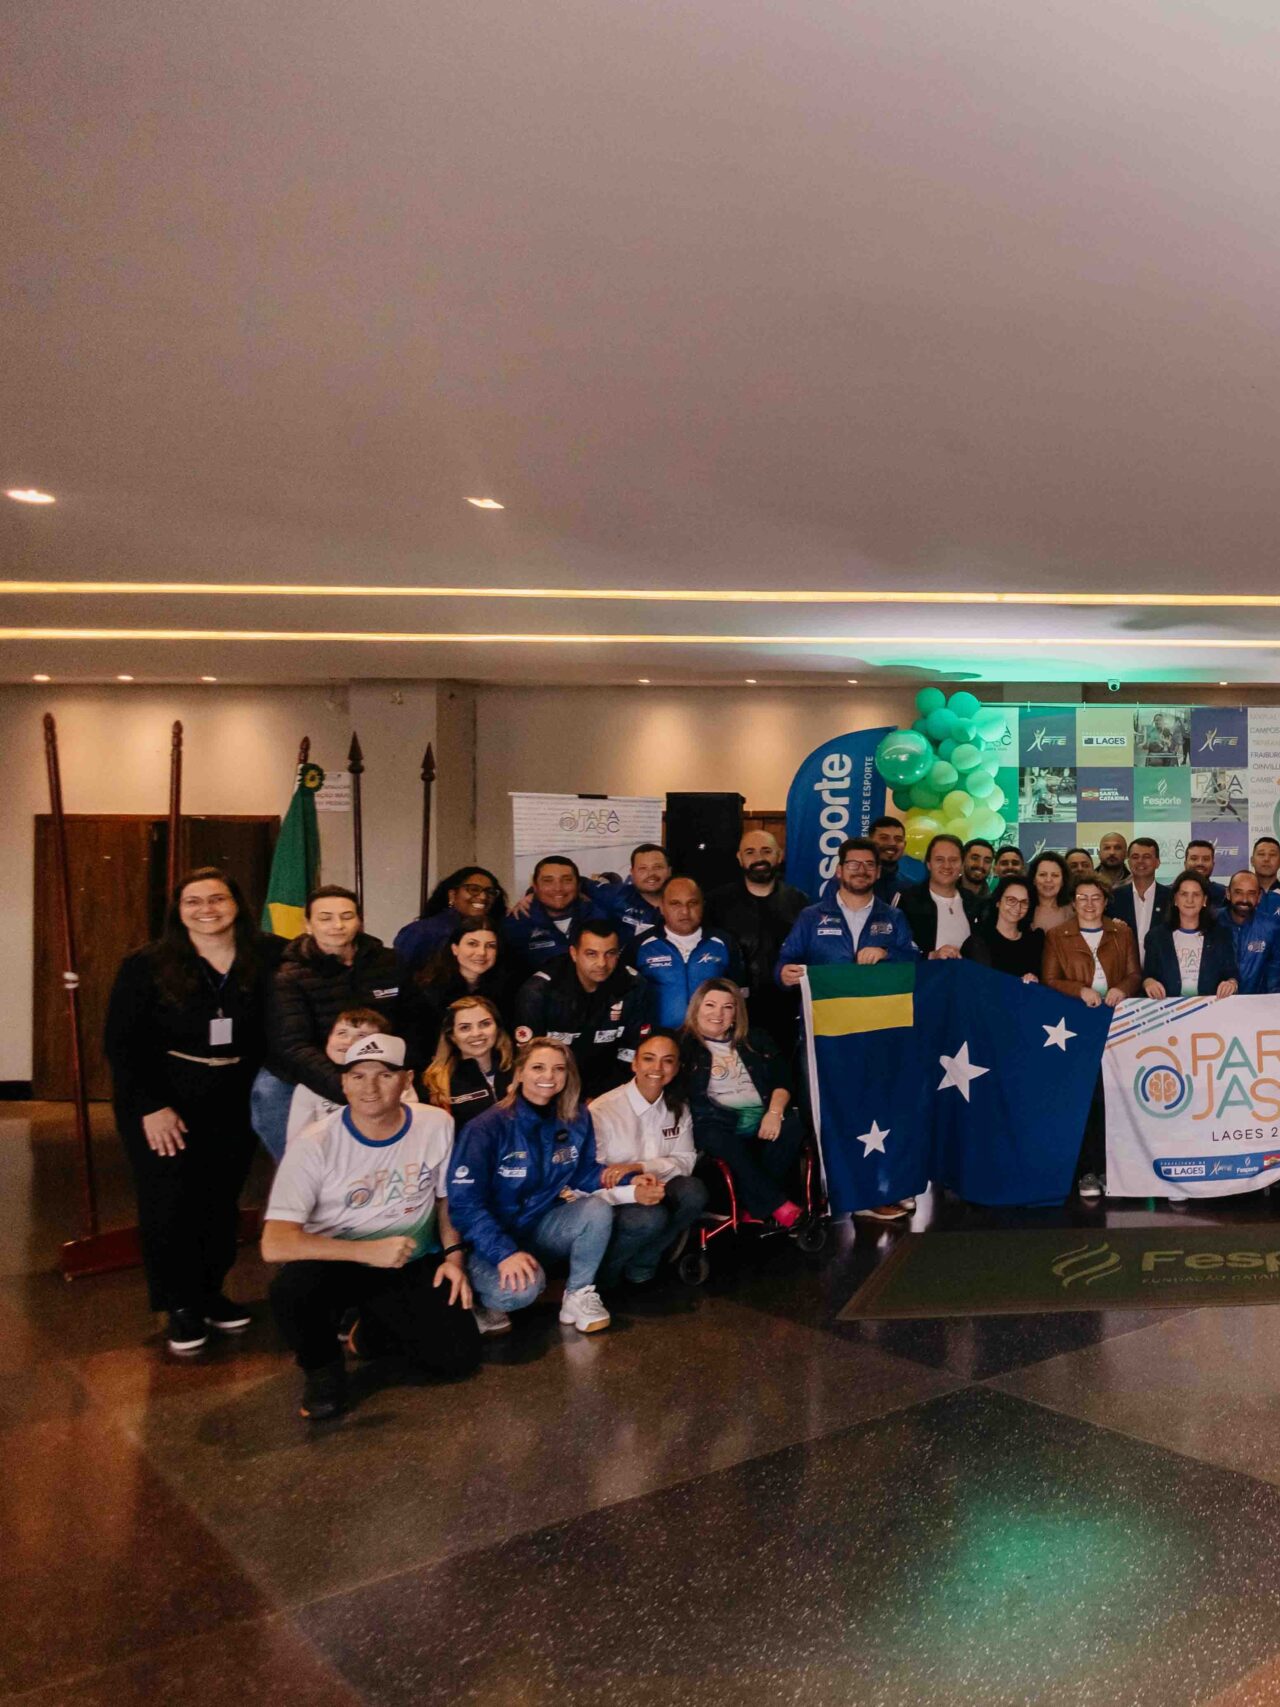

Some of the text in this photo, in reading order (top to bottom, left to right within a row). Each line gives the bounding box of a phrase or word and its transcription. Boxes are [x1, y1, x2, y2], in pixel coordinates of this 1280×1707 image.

[1096, 737, 1126, 745] LAGES
[862, 755, 873, 797] ESPORTE
[861, 800, 870, 811] DE
[1143, 796, 1182, 806] Fesporte
[577, 808, 620, 822] PARA
[577, 820, 621, 834] JASC
[1212, 1128, 1264, 1142] LAGES
[374, 1161, 433, 1190] PARA
[1174, 1166, 1204, 1175] LAGES
